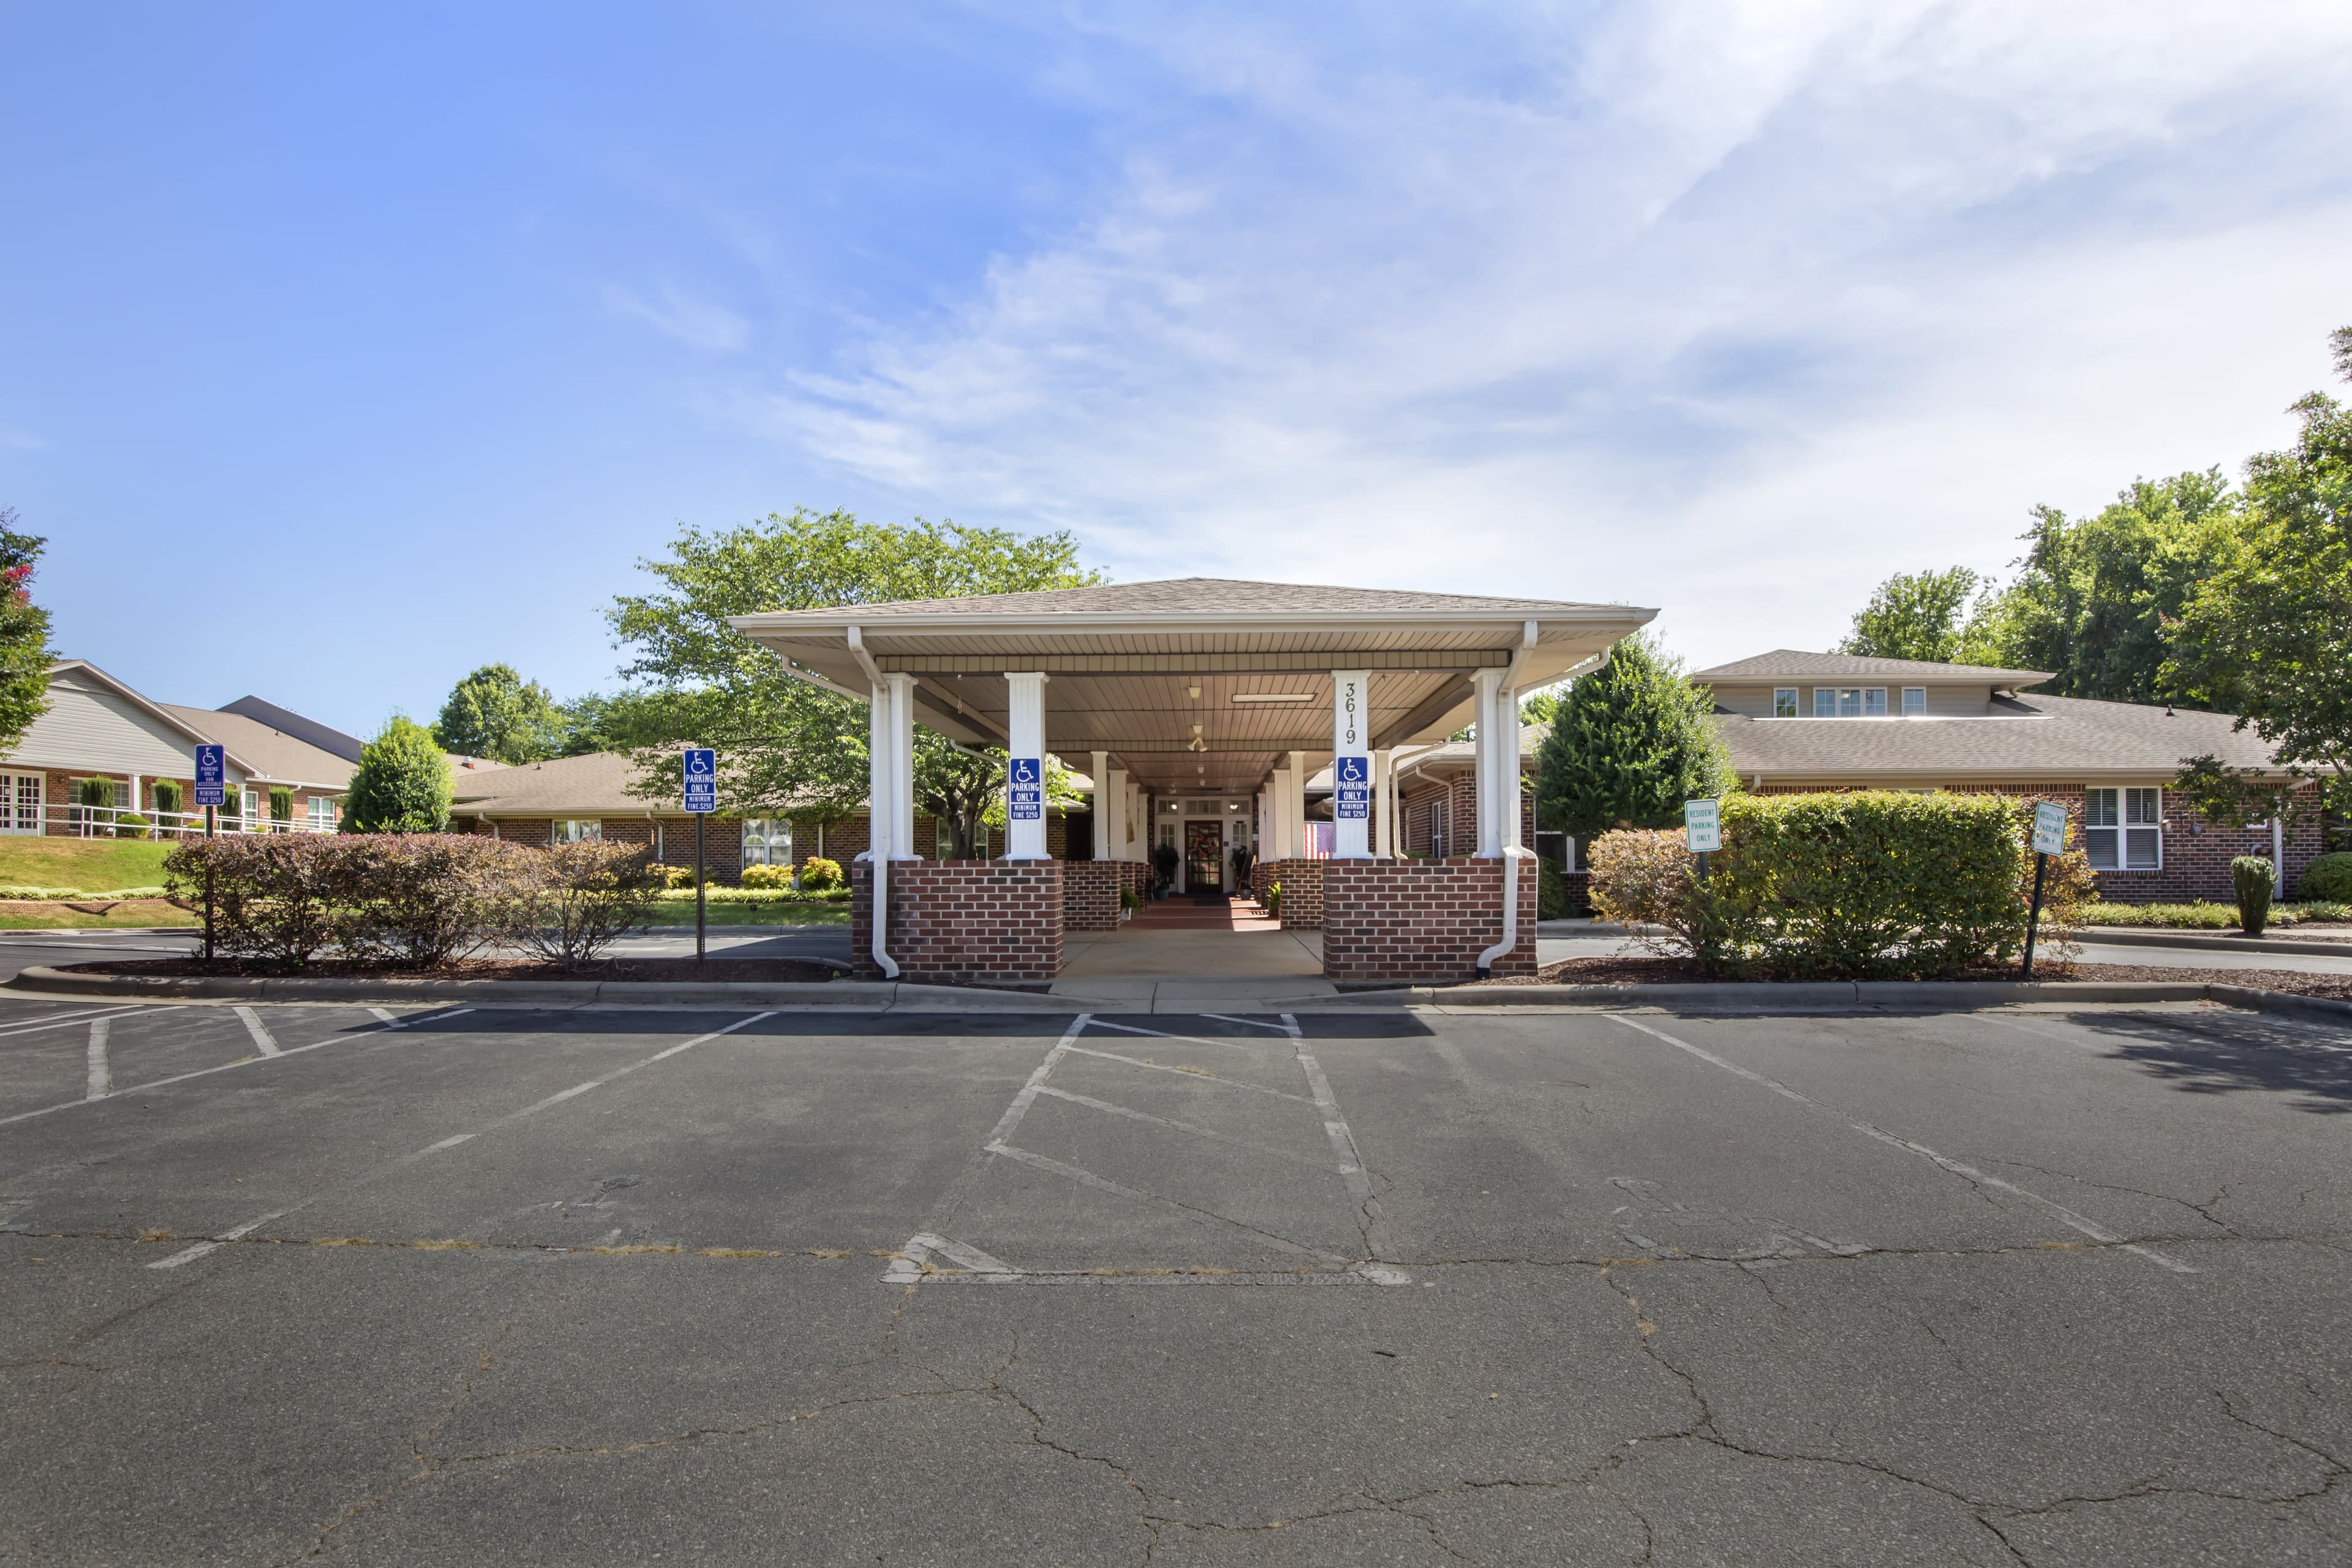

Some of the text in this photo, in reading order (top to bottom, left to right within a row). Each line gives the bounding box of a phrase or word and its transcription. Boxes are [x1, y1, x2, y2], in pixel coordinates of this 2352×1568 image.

[1346, 682, 1355, 744] 3619
[686, 774, 714, 783] PARKING
[691, 784, 708, 793] ONLY
[1011, 783, 1039, 791] PARKING
[1338, 781, 1366, 790] PARKING
[1017, 793, 1034, 801] ONLY
[1344, 791, 1361, 800] ONLY
[1689, 809, 1714, 818] RESIDENT
[2039, 811, 2063, 823] RESIDENT
[2038, 823, 2060, 834] PARKING
[1697, 834, 1711, 842] ONLY
[2041, 835, 2055, 845] ONLY
